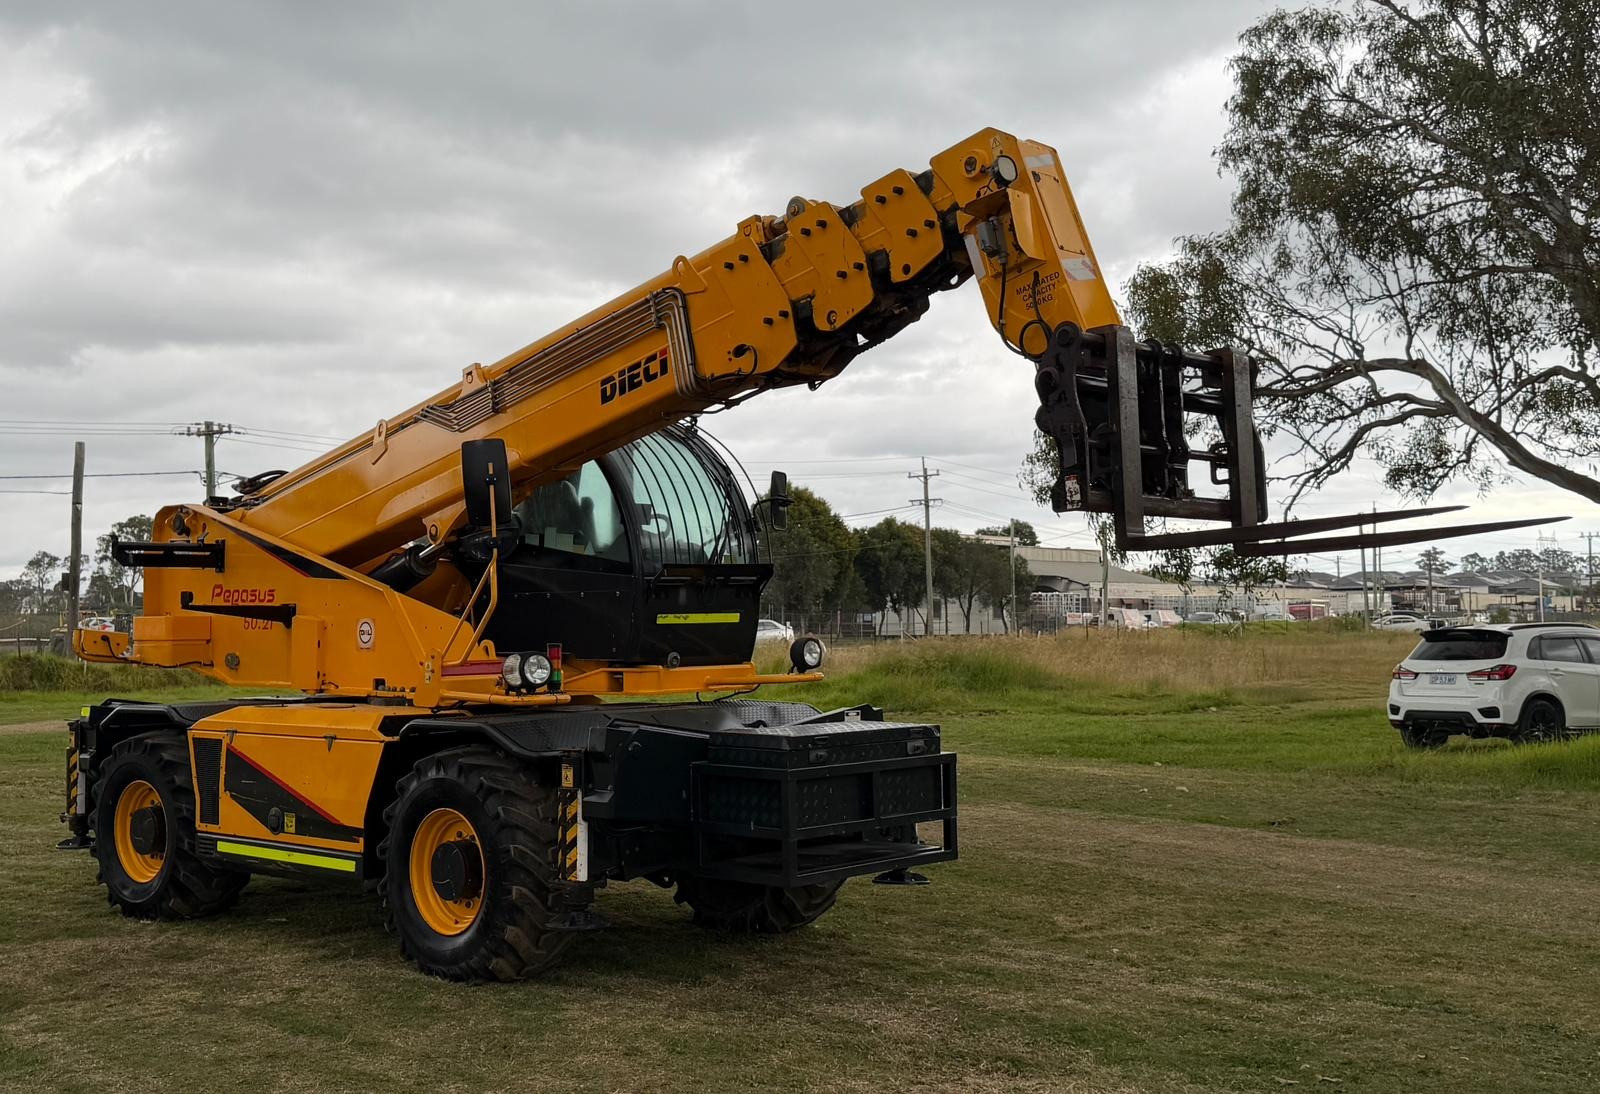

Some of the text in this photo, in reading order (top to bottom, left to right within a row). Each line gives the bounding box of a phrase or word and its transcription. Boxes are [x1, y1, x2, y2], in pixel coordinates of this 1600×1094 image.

[1038, 271, 1060, 285] ATED
[1022, 282, 1056, 302] CAACITY
[600, 346, 669, 405] DIECI
[211, 583, 276, 605] Pegasus
